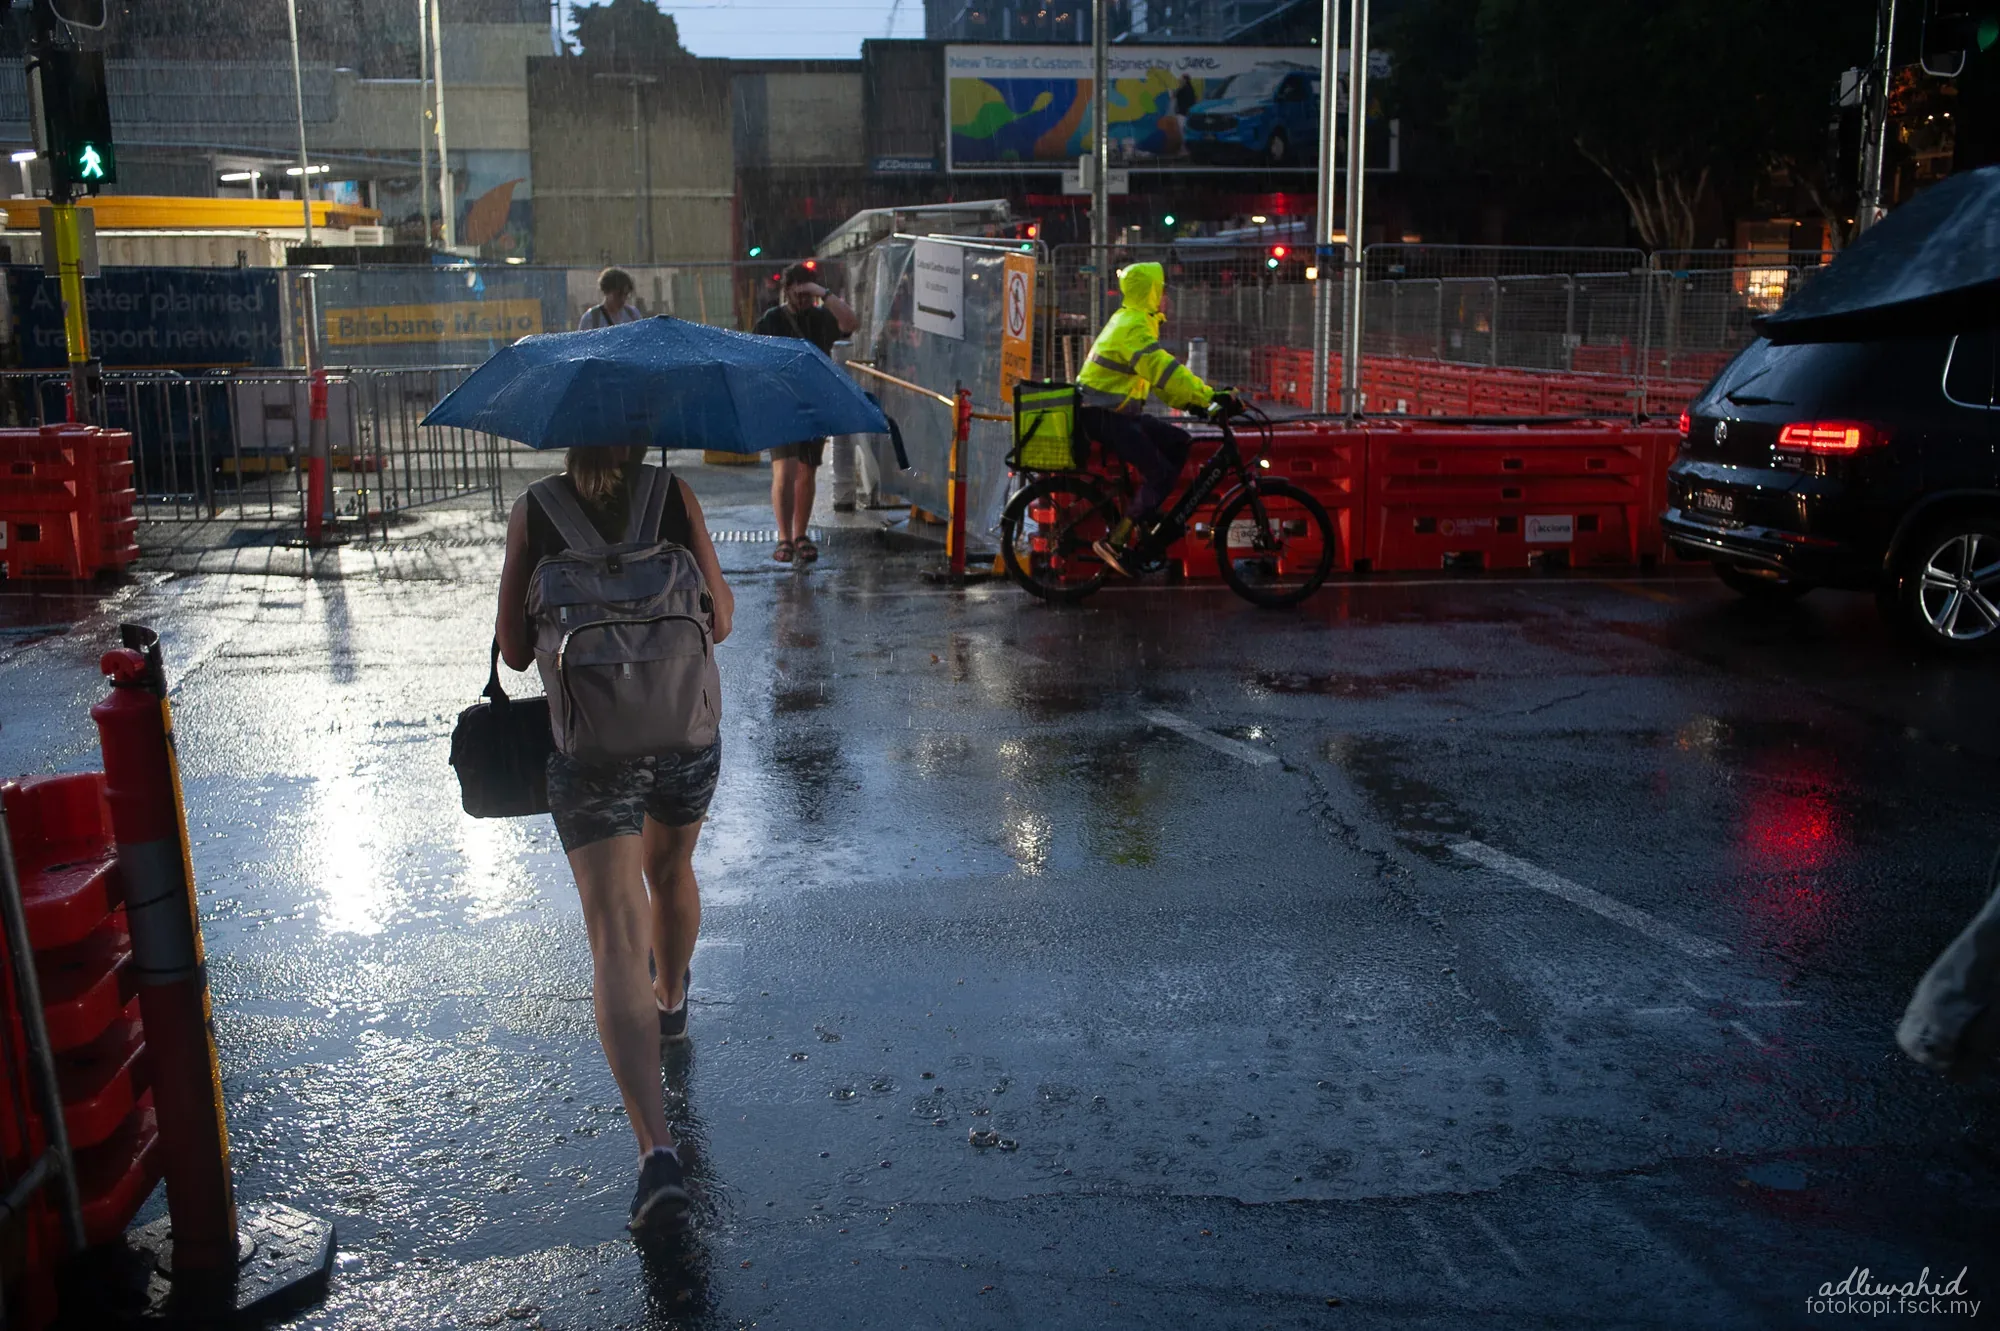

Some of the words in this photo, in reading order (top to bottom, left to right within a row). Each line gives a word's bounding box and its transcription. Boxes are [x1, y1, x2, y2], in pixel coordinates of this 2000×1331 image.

[949, 56, 980, 69] New
[983, 56, 1029, 69] Transit
[1155, 57, 1172, 71] by
[876, 160, 932, 170] JCDecaux
[30, 283, 55, 310] A
[76, 287, 143, 312] etter
[151, 284, 262, 319] planned
[339, 313, 445, 338] Brisbane
[453, 312, 533, 334] Metro
[33, 326, 159, 355] trasport
[166, 323, 282, 349] network
[1537, 521, 1571, 533] acciona
